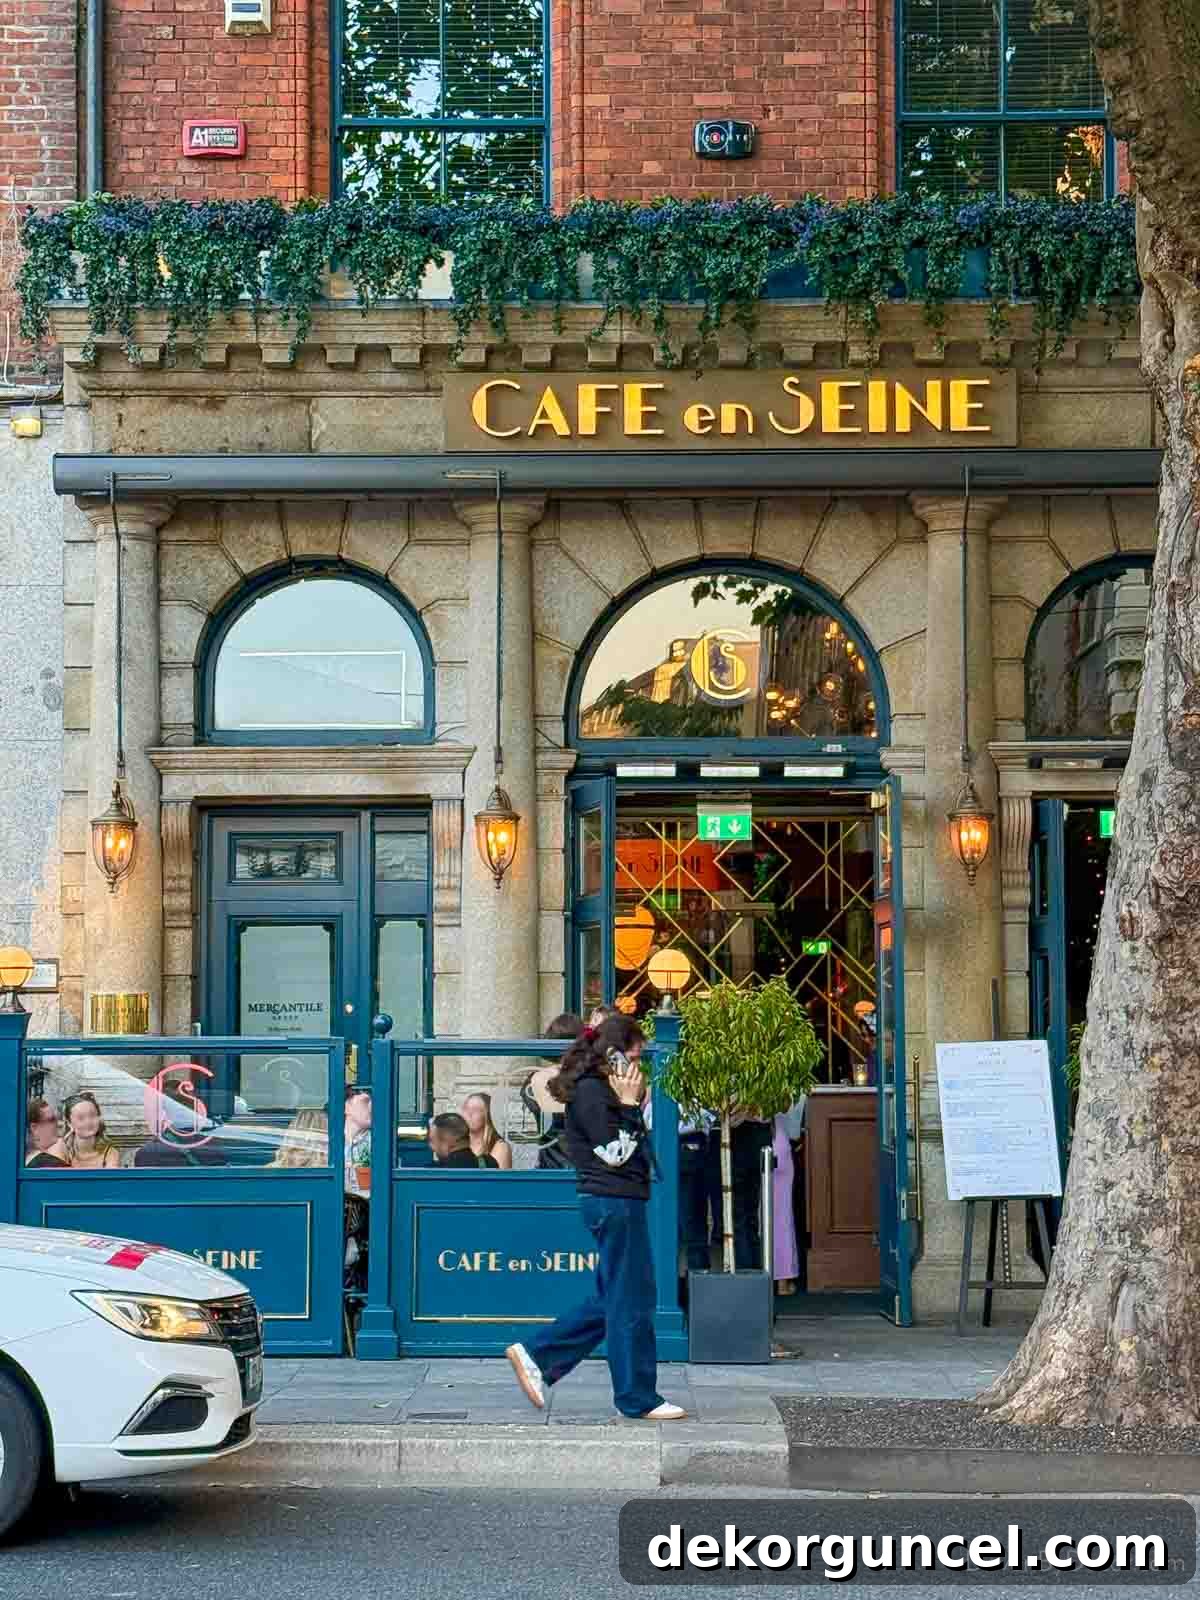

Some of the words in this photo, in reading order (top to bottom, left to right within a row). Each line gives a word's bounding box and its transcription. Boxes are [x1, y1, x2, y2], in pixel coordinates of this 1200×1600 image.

[192, 127, 208, 147] A1
[472, 379, 664, 437] CAFE
[683, 403, 753, 434] en
[769, 376, 991, 434] SEINE
[248, 1002, 323, 1014] MERCANTILE
[438, 1249, 503, 1271] CAFE
[508, 1260, 532, 1272] en
[536, 1250, 600, 1272] SEIN
